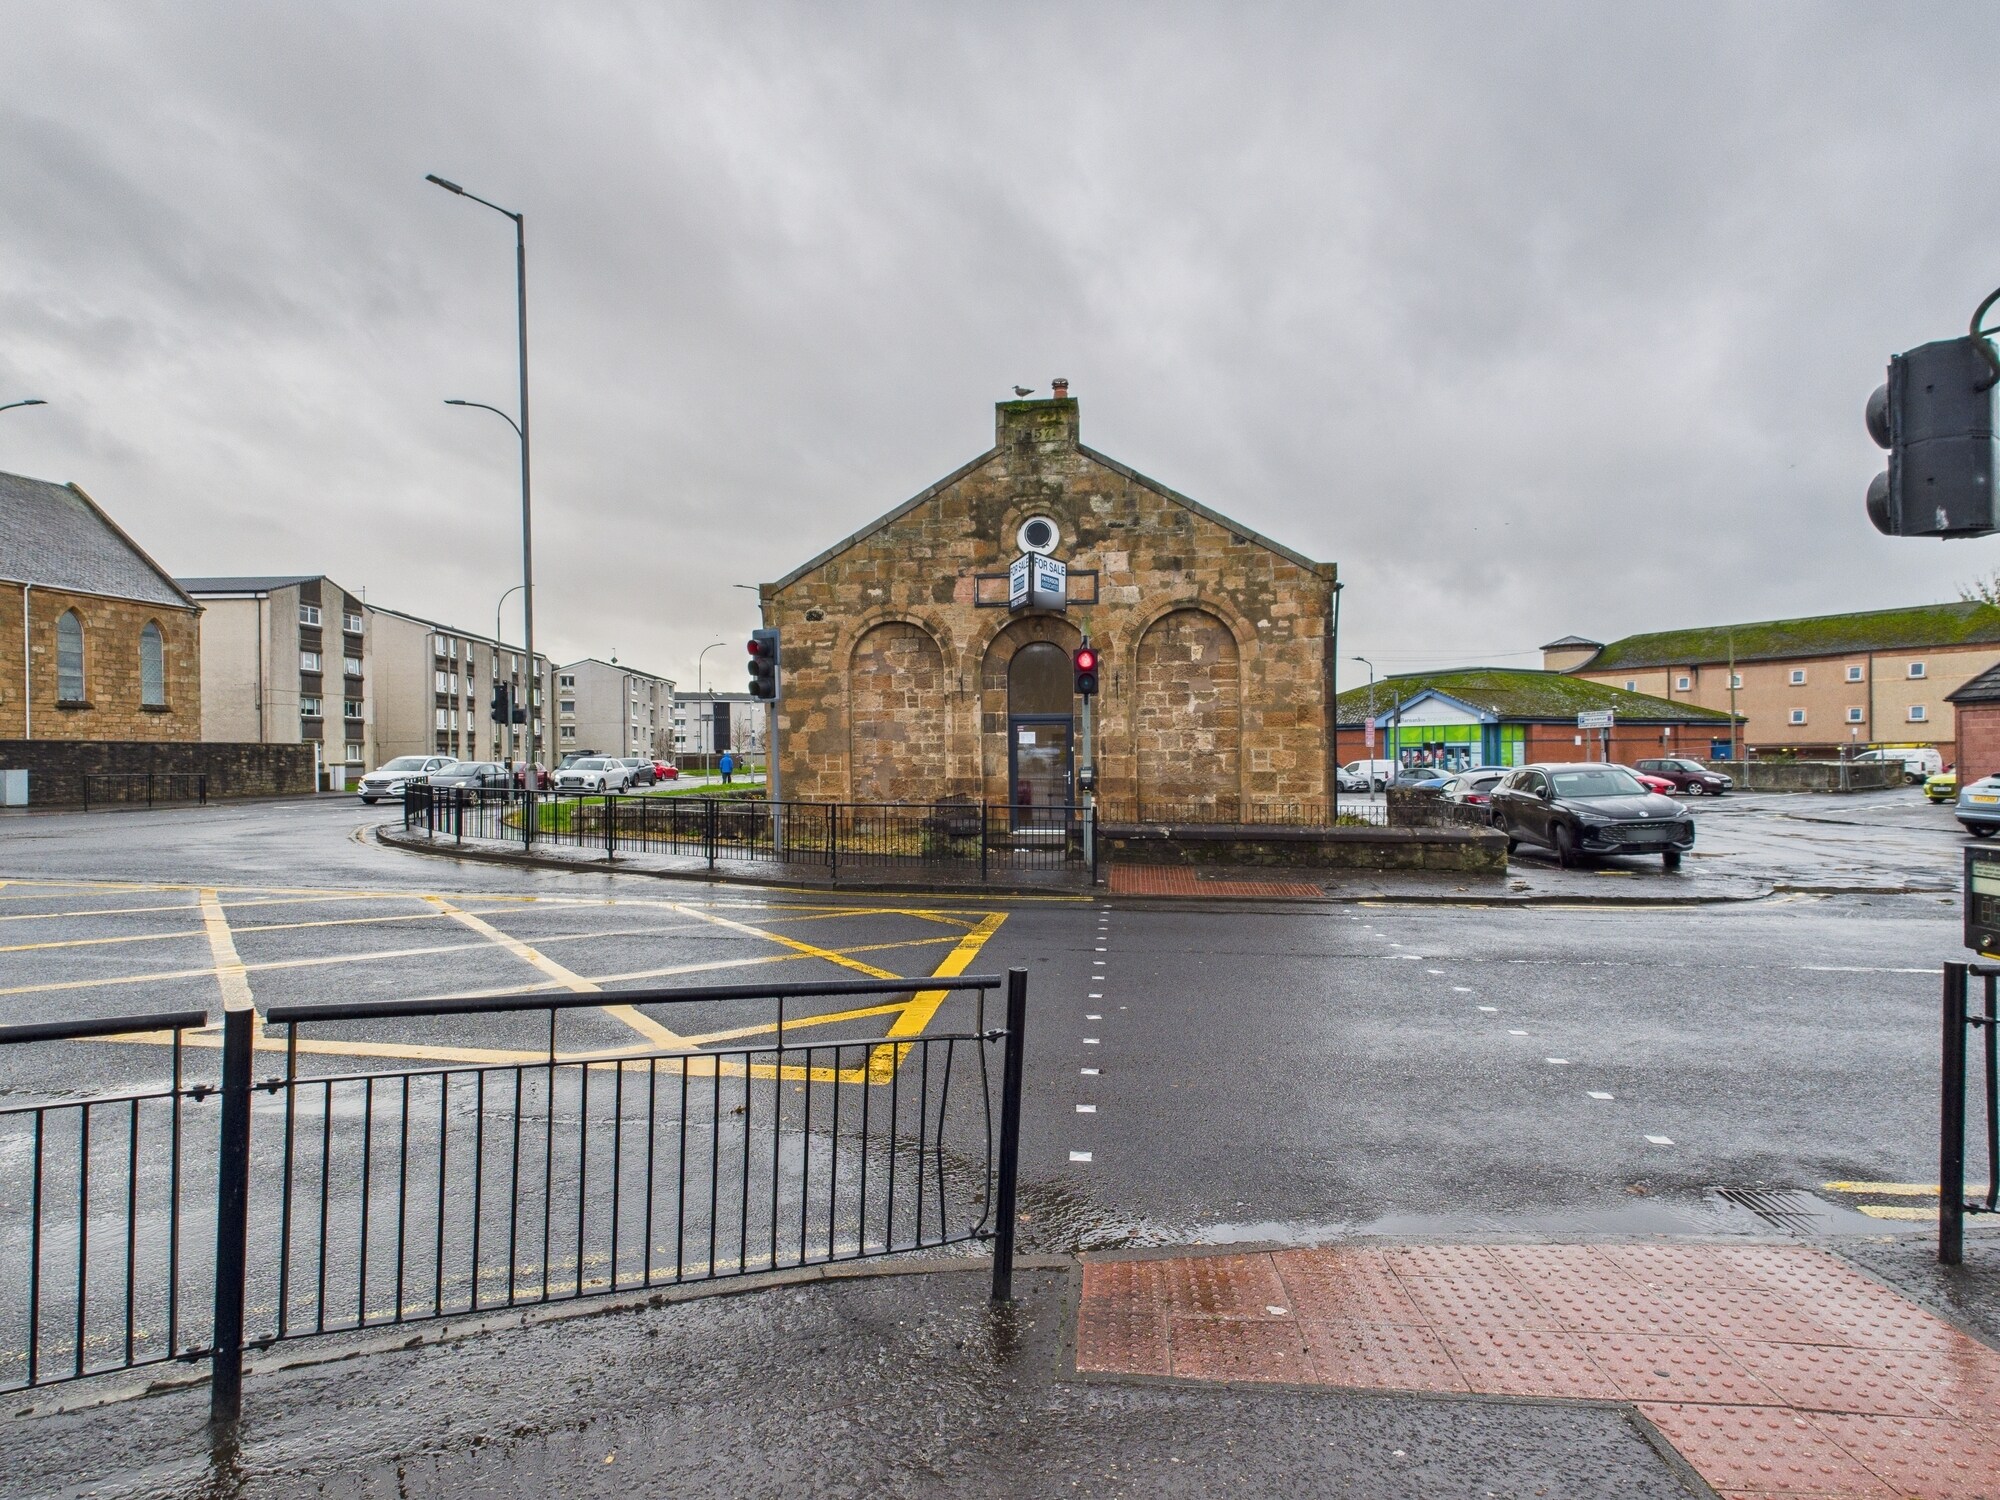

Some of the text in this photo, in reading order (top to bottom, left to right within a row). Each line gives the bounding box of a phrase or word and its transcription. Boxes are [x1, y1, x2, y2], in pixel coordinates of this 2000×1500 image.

[1010, 558, 1029, 576] FOR SALE
[1034, 557, 1065, 576] FOR SALE
